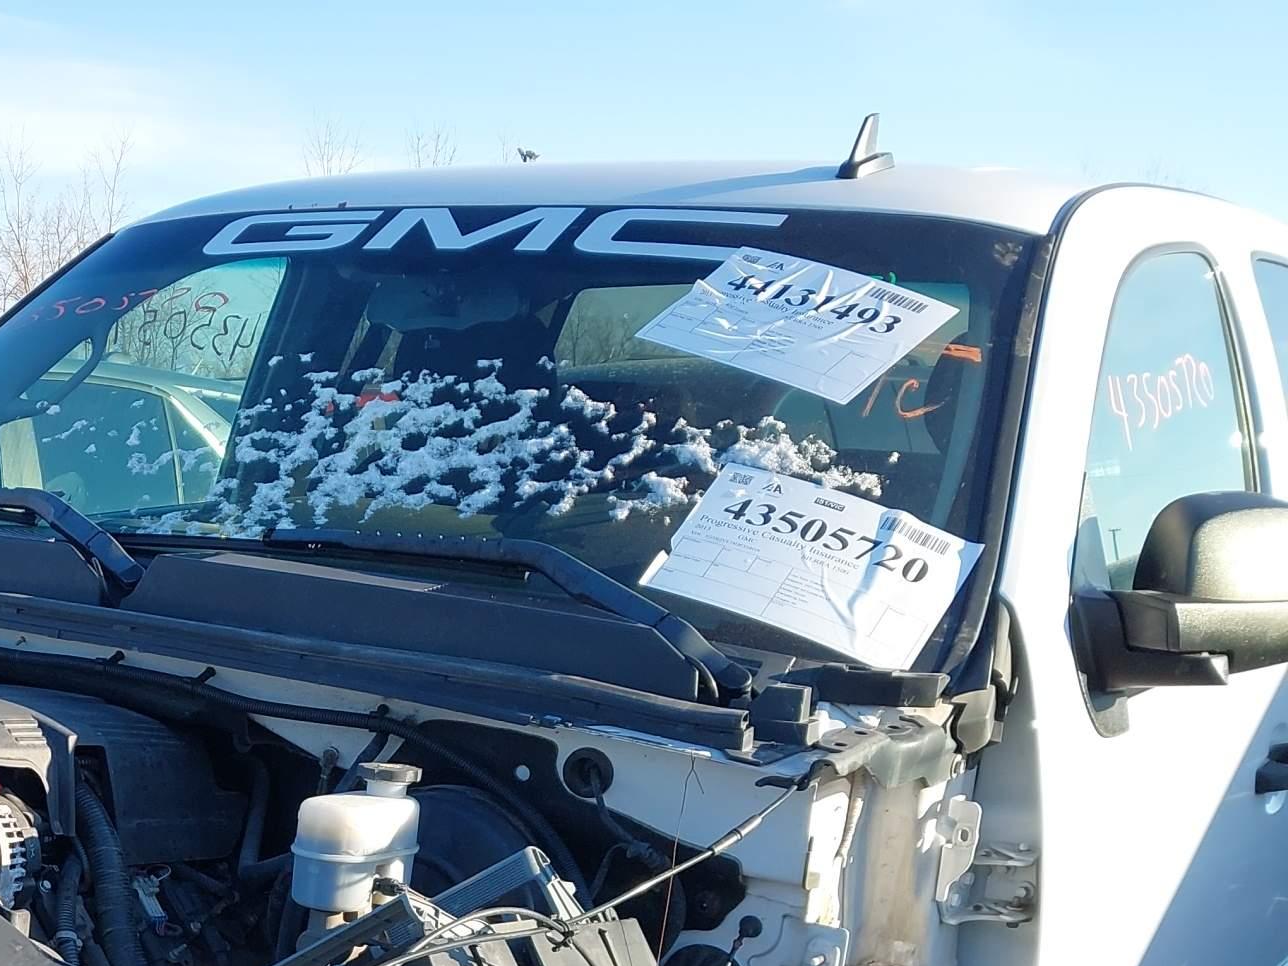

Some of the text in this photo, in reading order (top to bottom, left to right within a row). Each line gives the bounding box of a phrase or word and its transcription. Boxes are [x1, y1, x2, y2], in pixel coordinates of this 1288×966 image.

[202, 206, 789, 261] GMC
[728, 274, 902, 333] 44131493
[1108, 353, 1214, 451] 43505720
[699, 514, 760, 536] Progressive
[761, 531, 807, 552] Casualty
[808, 546, 860, 570] Insurance
[724, 499, 929, 583] 43505720
